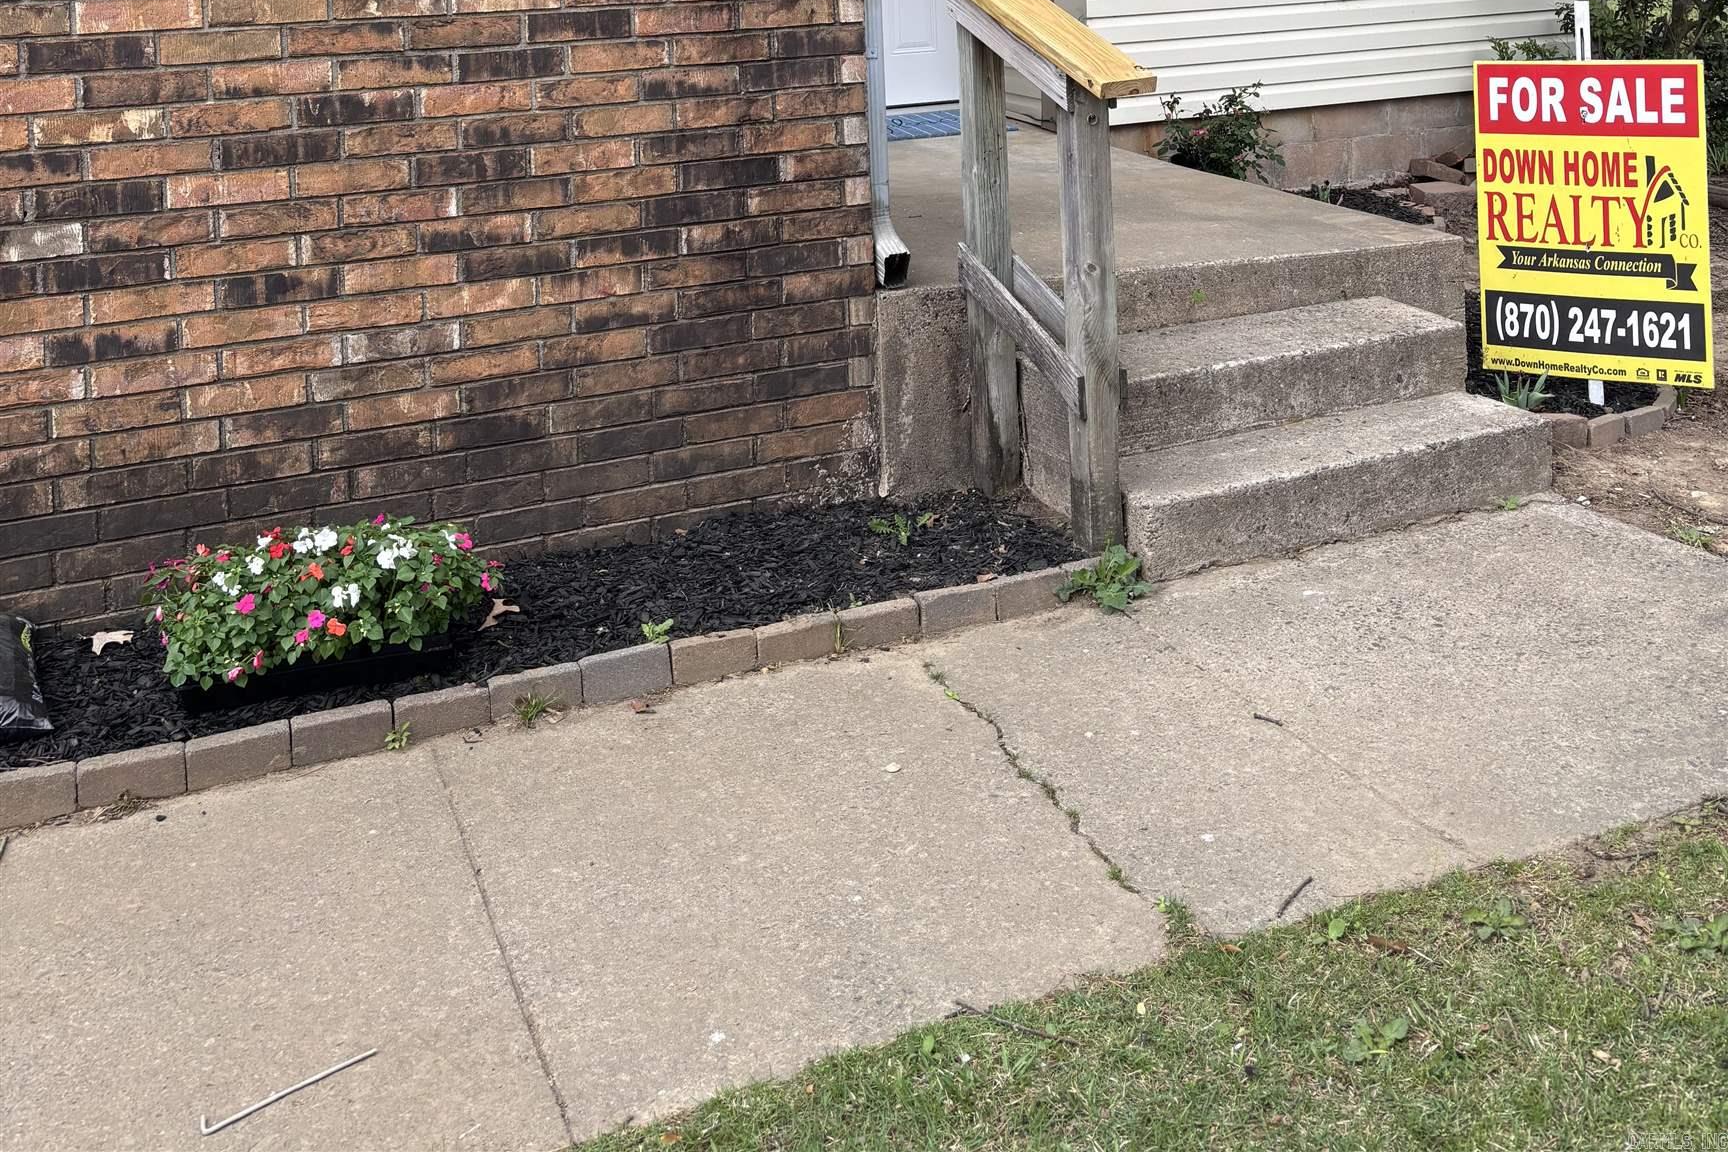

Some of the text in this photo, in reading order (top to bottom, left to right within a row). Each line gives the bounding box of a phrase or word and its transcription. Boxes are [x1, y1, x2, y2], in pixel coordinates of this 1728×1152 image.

[1489, 77, 1686, 124] FOR SALE
[1483, 148, 1638, 188] DOWN HOME
[1484, 191, 1702, 249] REALTY CO.
[1511, 250, 1662, 273] Your Arkansas Connection
[1496, 296, 1692, 350] (870) 247-1621
[1491, 357, 1627, 377] www.DownHomeRealtyCo.com
[1674, 373, 1703, 384] MLS
